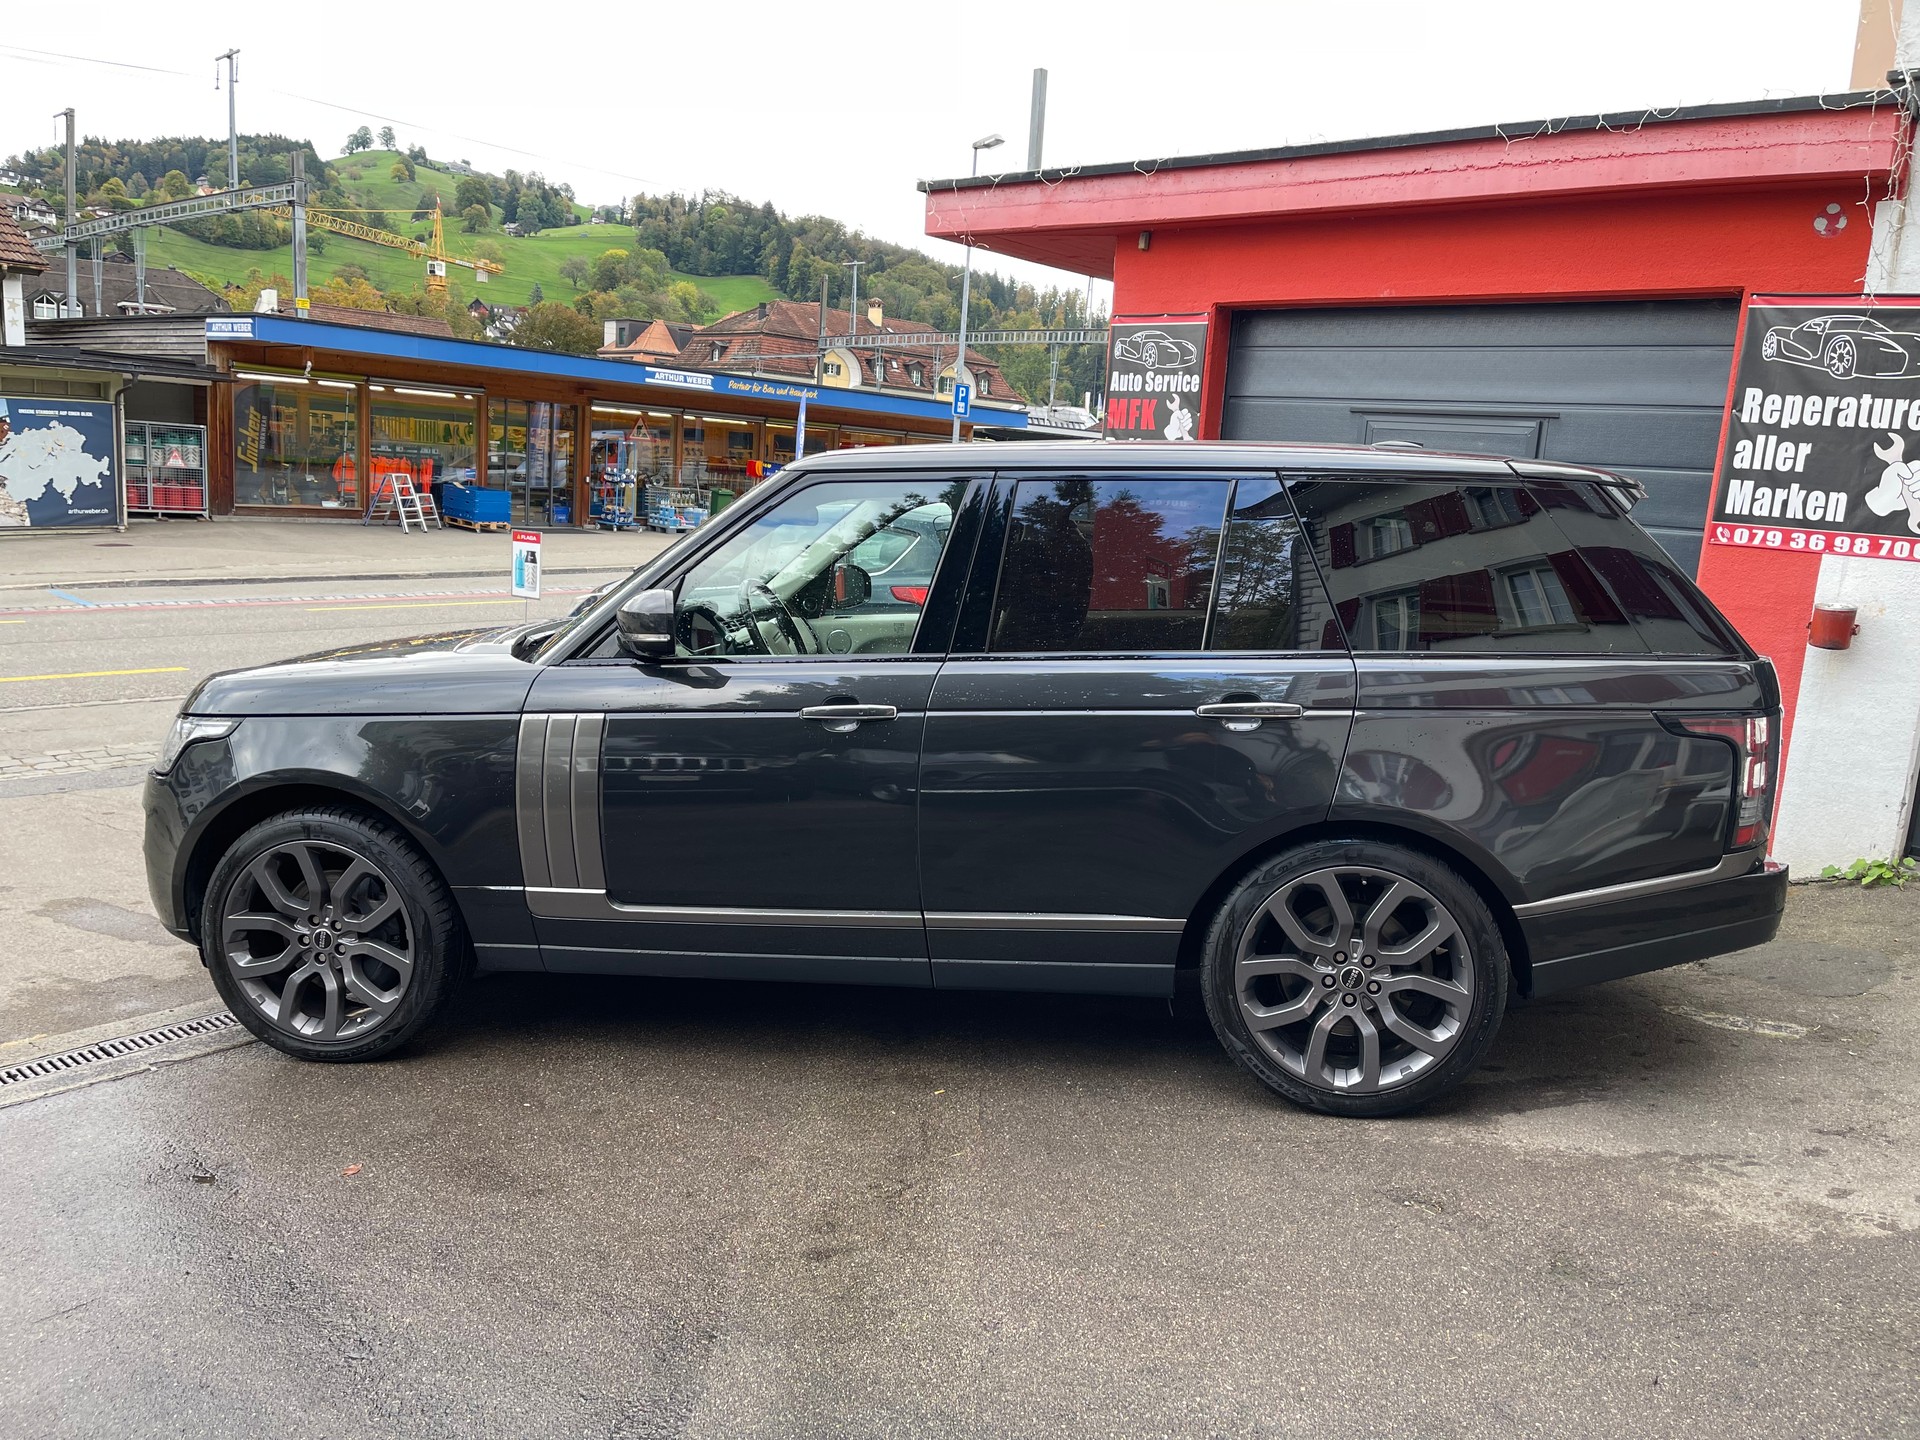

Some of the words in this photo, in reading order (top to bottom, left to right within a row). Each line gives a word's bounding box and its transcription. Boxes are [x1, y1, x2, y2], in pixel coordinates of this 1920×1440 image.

[211, 323, 232, 332] ARTHUR
[233, 323, 252, 332] WEBER
[654, 372, 685, 383] ARTHUR
[686, 375, 712, 386] WEBER
[728, 380, 751, 391] Partner
[751, 382, 762, 393] für
[762, 383, 775, 395] Bau
[776, 385, 790, 396] und
[1110, 371, 1143, 392] Auto
[1145, 371, 1200, 393] Service
[959, 387, 967, 402] P
[1107, 398, 1157, 430] MFK
[237, 405, 261, 474] Snickers
[260, 415, 268, 450] WORKWEAR
[1732, 434, 1812, 472] aller
[1725, 479, 1848, 523] Marken
[1733, 528, 1783, 547] 079
[1789, 532, 1826, 551] 36
[1833, 535, 1871, 554] 98
